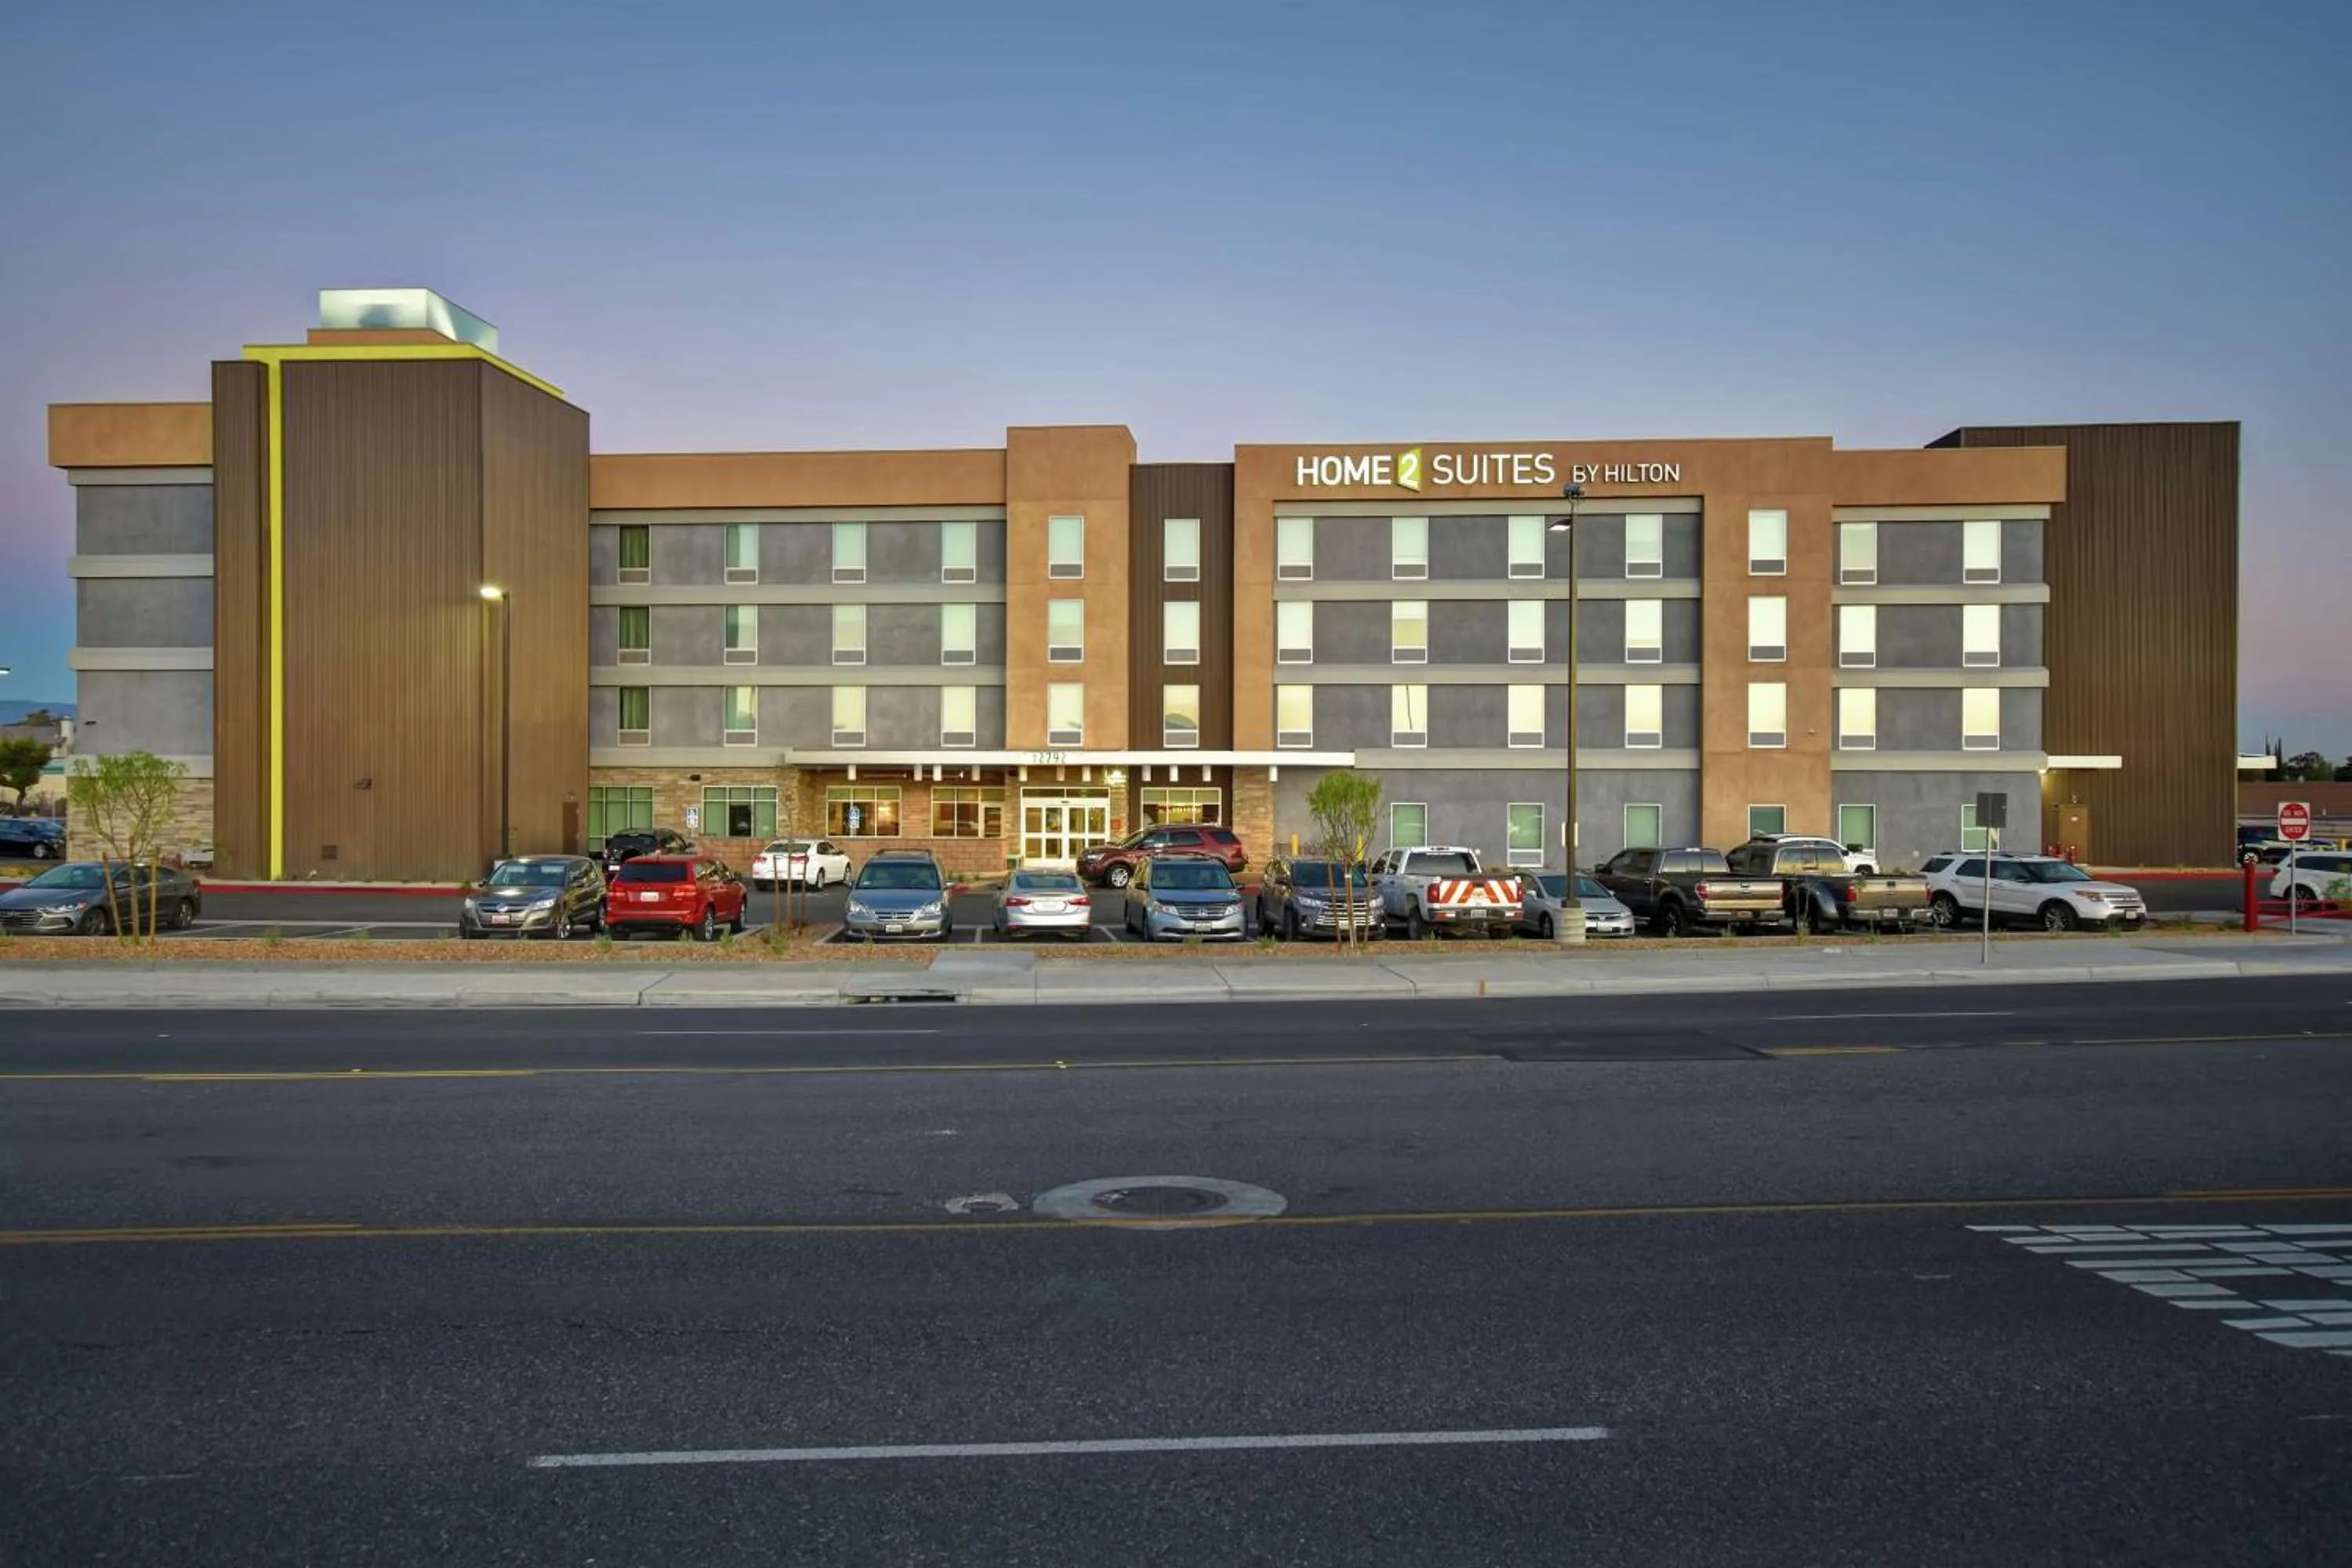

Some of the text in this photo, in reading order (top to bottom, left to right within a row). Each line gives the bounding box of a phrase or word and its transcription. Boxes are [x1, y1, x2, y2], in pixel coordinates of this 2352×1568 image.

[1298, 453, 1680, 489] HOME 2 SUITES BY HILTON
